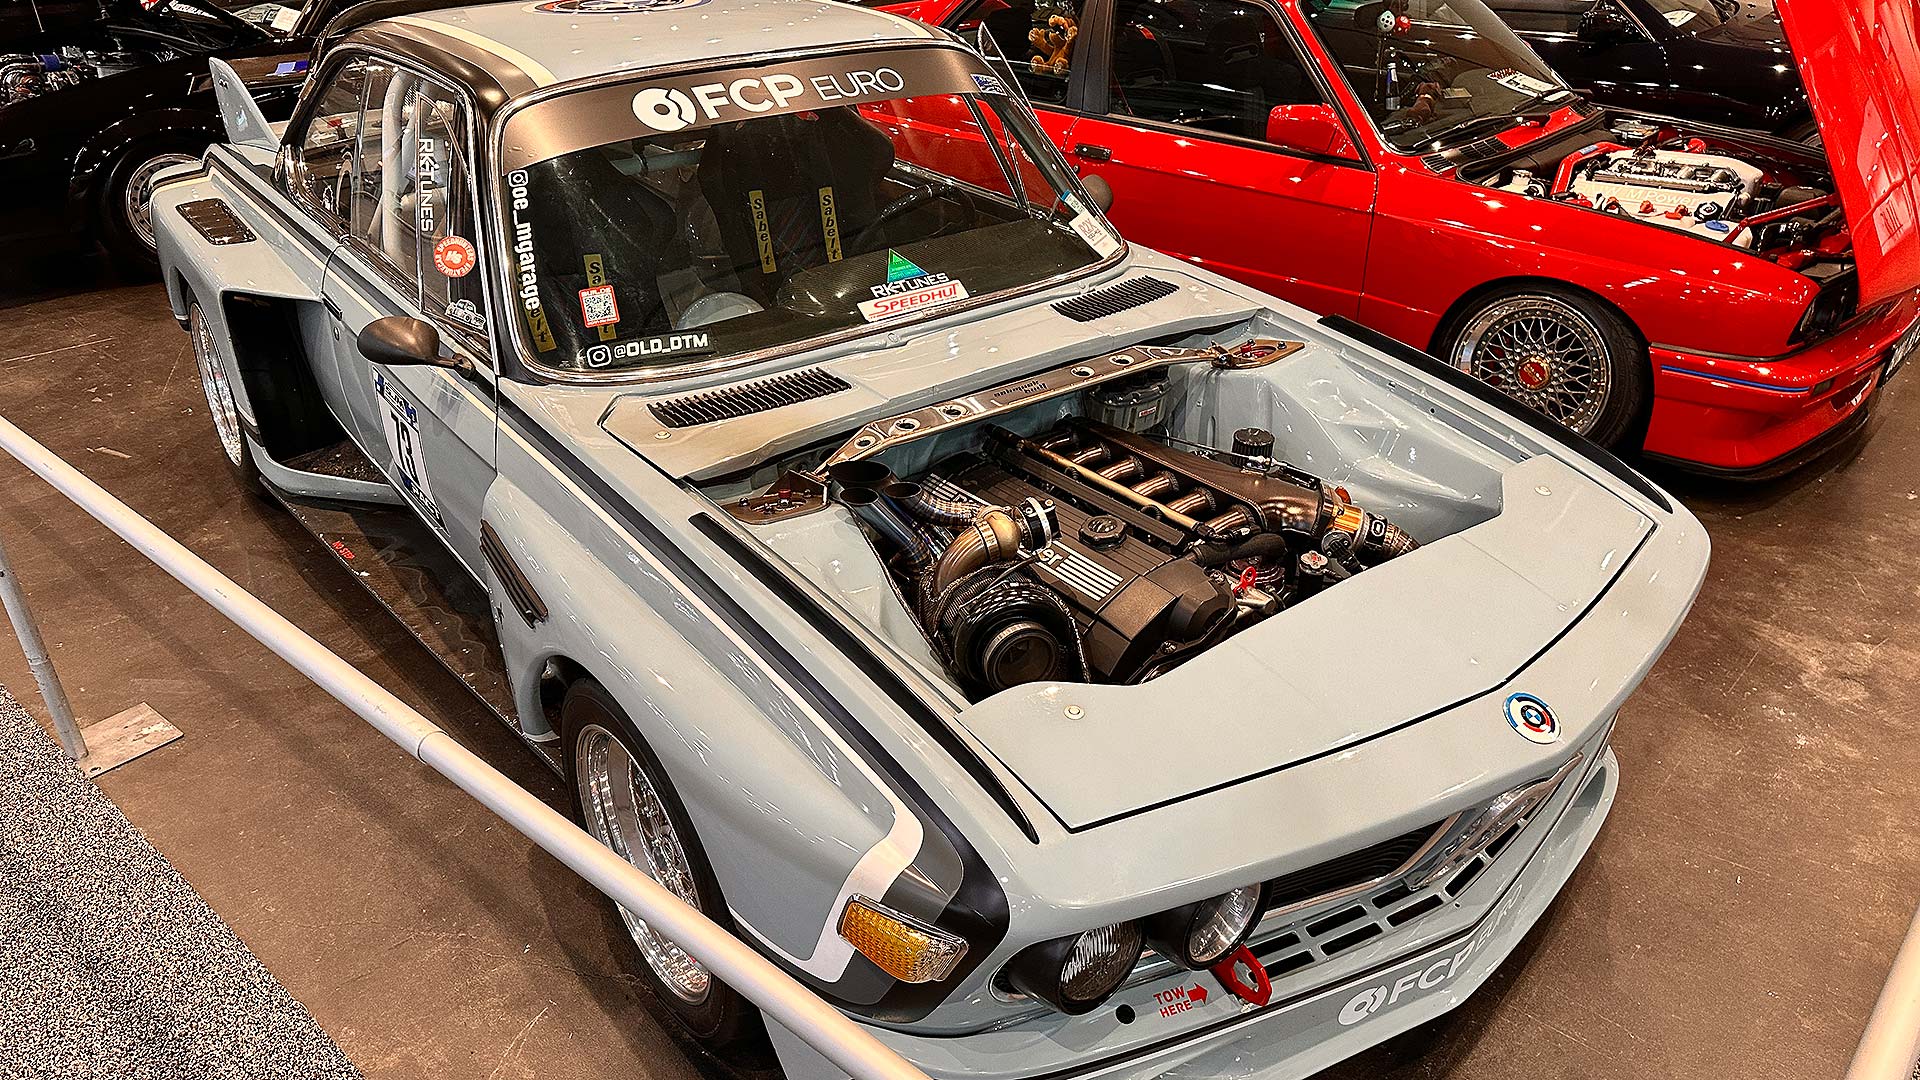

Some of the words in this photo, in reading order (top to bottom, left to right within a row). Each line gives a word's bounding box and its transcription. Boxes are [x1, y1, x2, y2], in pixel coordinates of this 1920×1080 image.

[690, 73, 805, 120] FCP
[809, 67, 905, 102] EURO
[1645, 190, 1699, 207] Power
[753, 198, 772, 266] Sabelt
[822, 194, 840, 260] Sabelt
[872, 283, 960, 314] SPEEDHUT
[614, 333, 709, 358] @OLD_DTM
[390, 410, 421, 488] 73
[331, 540, 345, 550] NO
[1388, 940, 1475, 1005] FCP
[1153, 985, 1185, 1005] TOW
[1159, 999, 1193, 1018] HERE
